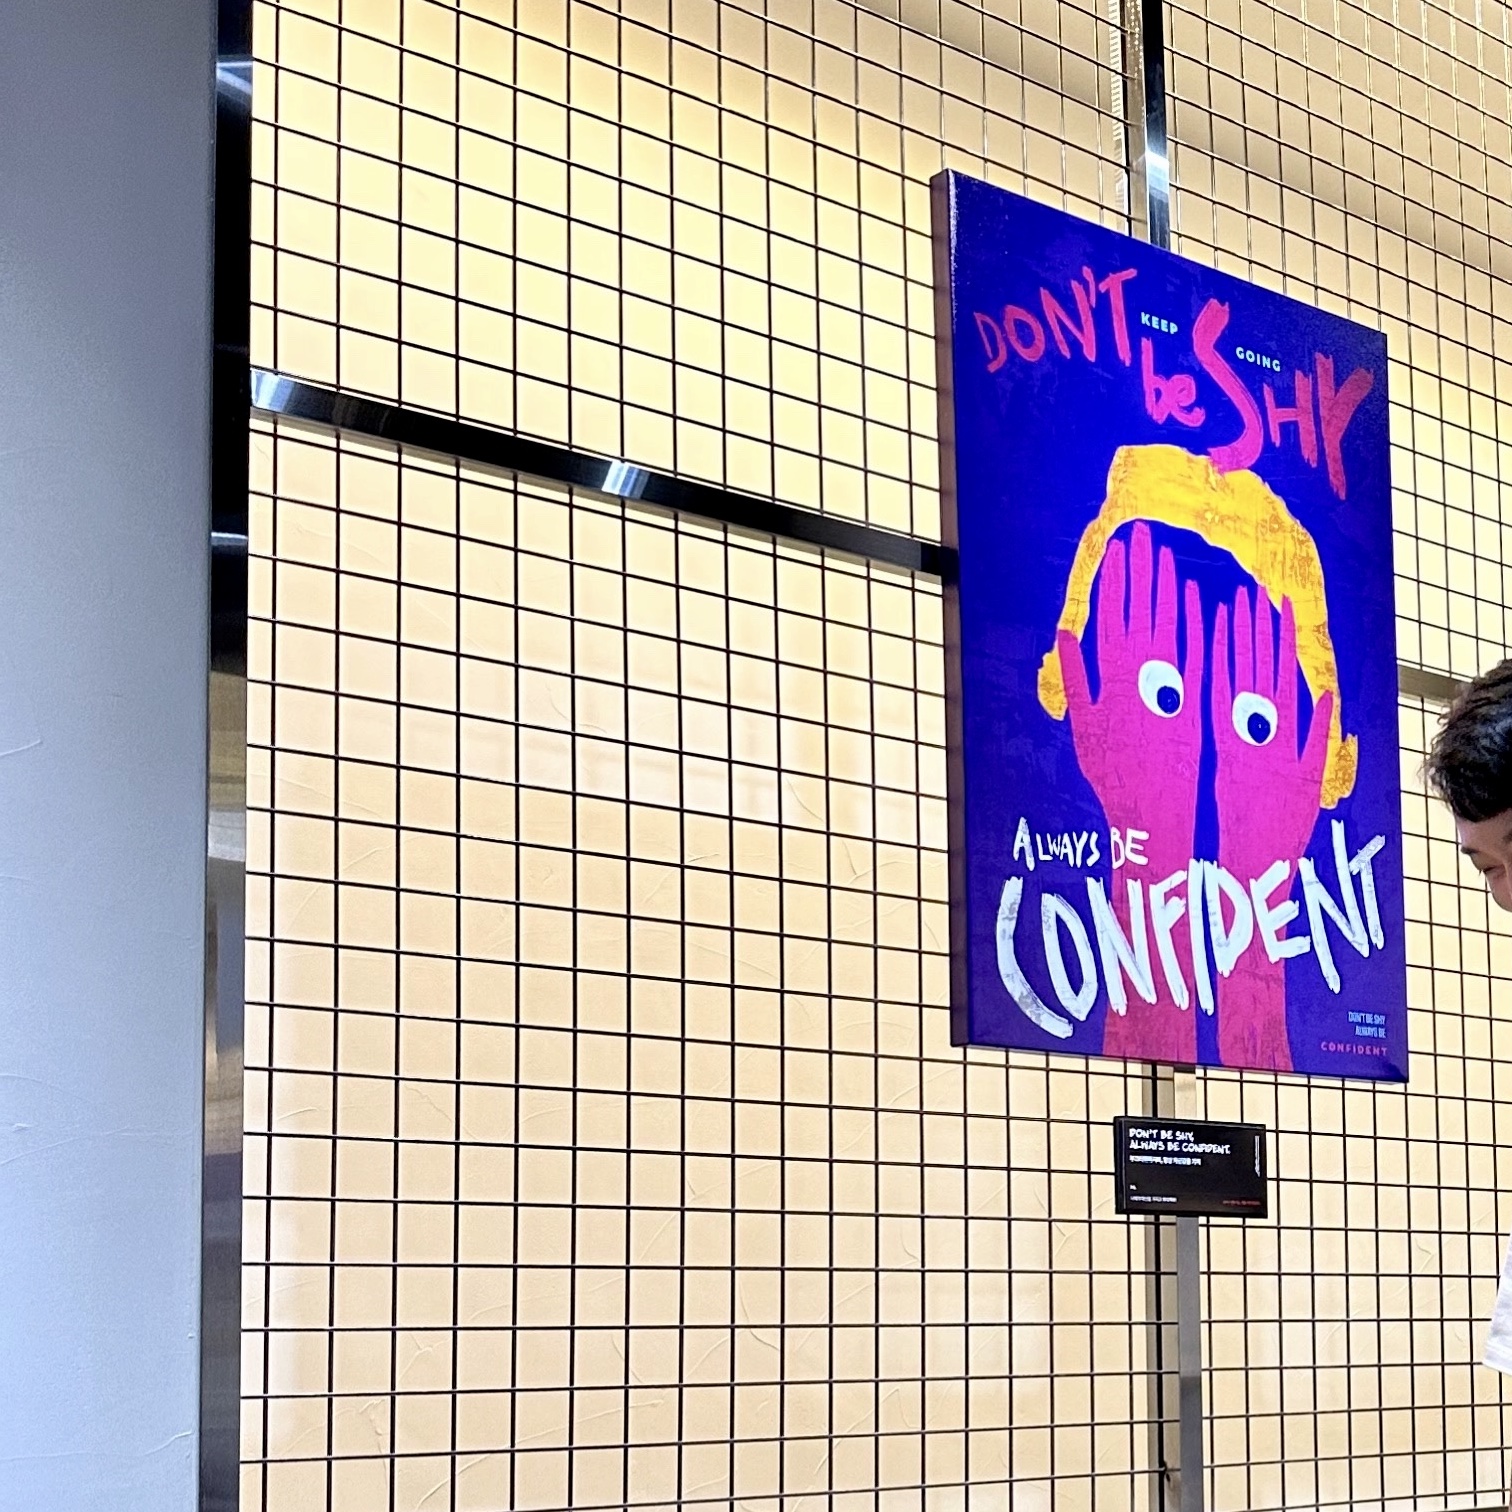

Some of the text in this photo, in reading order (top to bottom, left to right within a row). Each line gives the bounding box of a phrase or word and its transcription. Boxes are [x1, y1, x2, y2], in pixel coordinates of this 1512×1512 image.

[1141, 312, 1281, 372] KEEP GOING
[974, 266, 1374, 500] DON'T be SHY
[1013, 816, 1150, 871] ALWAYS BE
[996, 819, 1386, 1039] CONFIDENT
[1321, 1041, 1387, 1056] CONFIDENT
